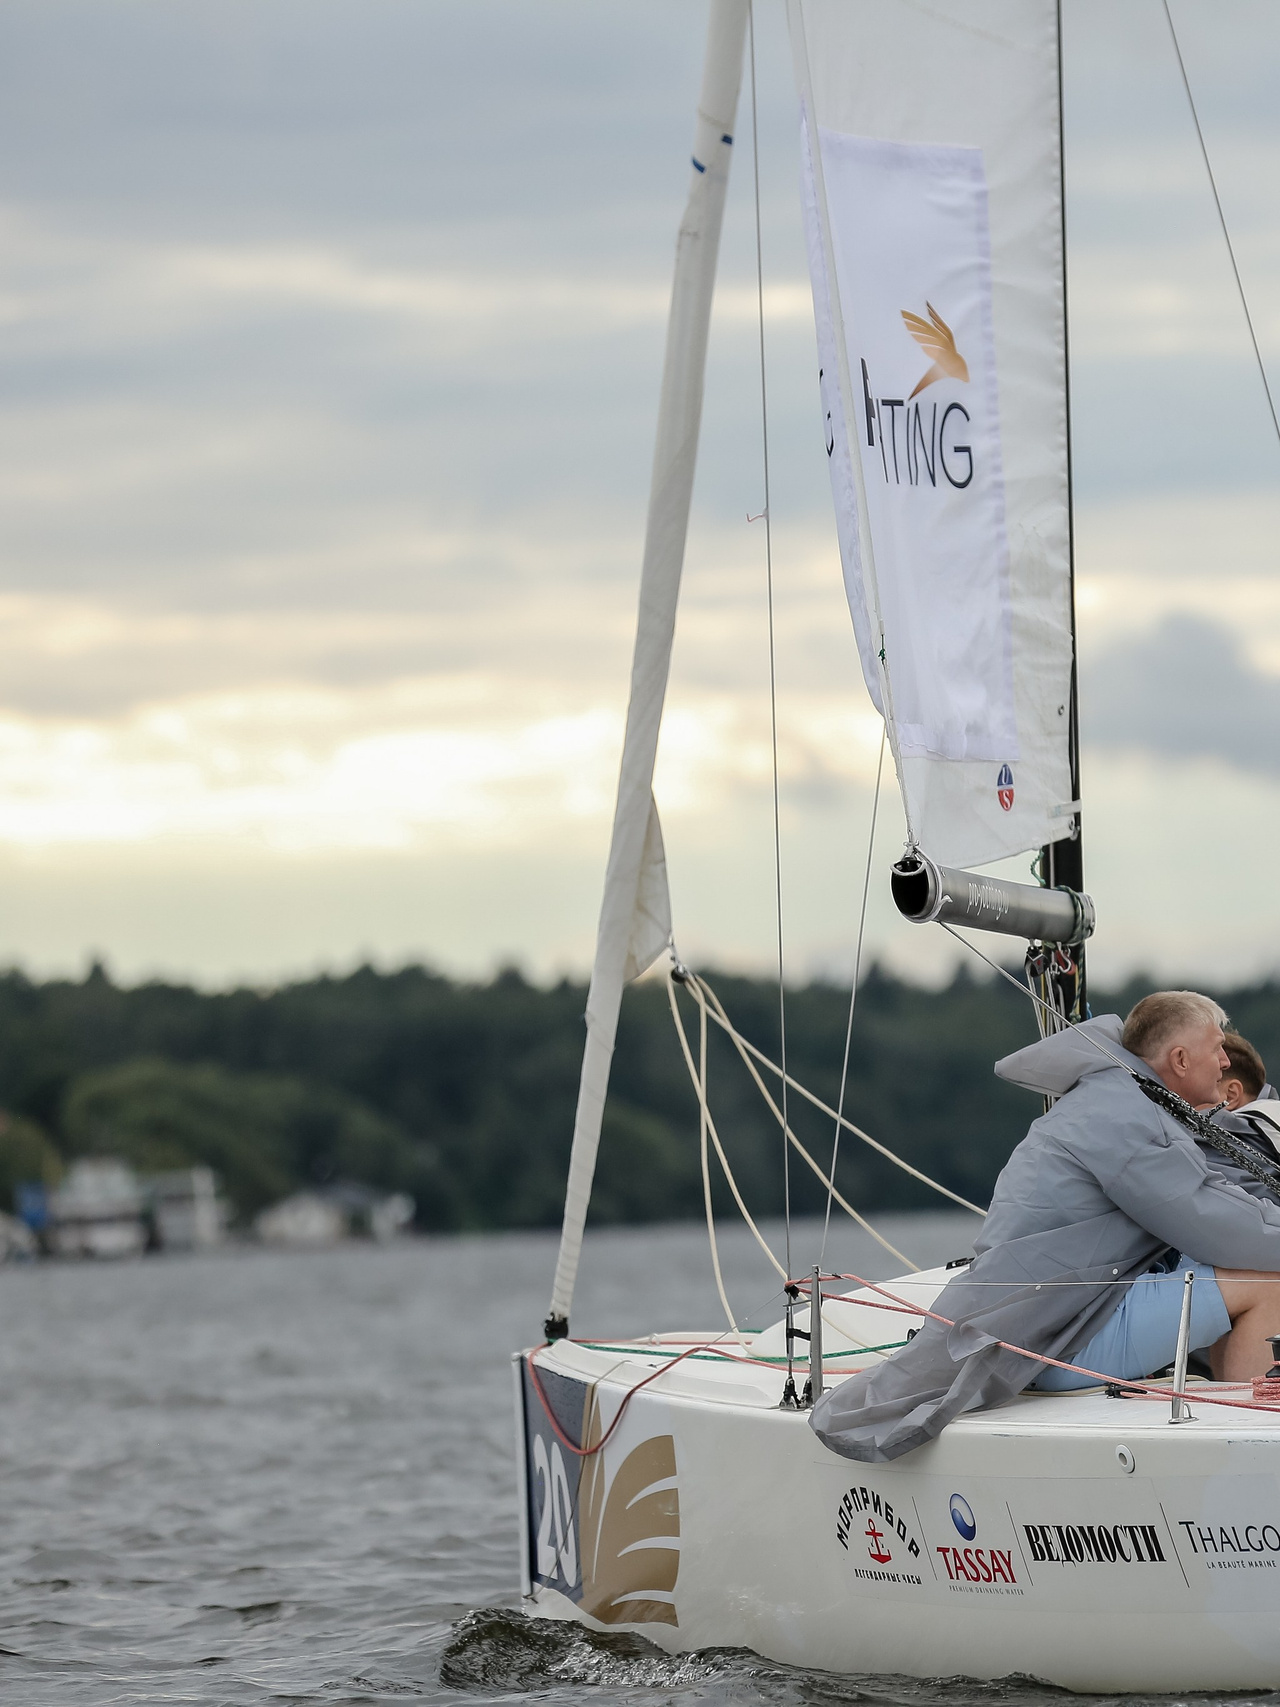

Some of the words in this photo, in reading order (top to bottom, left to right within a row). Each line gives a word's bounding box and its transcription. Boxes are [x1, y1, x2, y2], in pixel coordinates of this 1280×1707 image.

[533, 1433, 577, 1588] 20
[836, 1486, 921, 1559] МОРПРИБОР
[936, 1546, 1018, 1584] TASSAY
[1022, 1524, 1167, 1568] ВЕДОМОСТИ
[1206, 1561, 1217, 1570] LA
[1217, 1560, 1247, 1569] BEAUTÉ
[1247, 1560, 1278, 1569] MARINE
